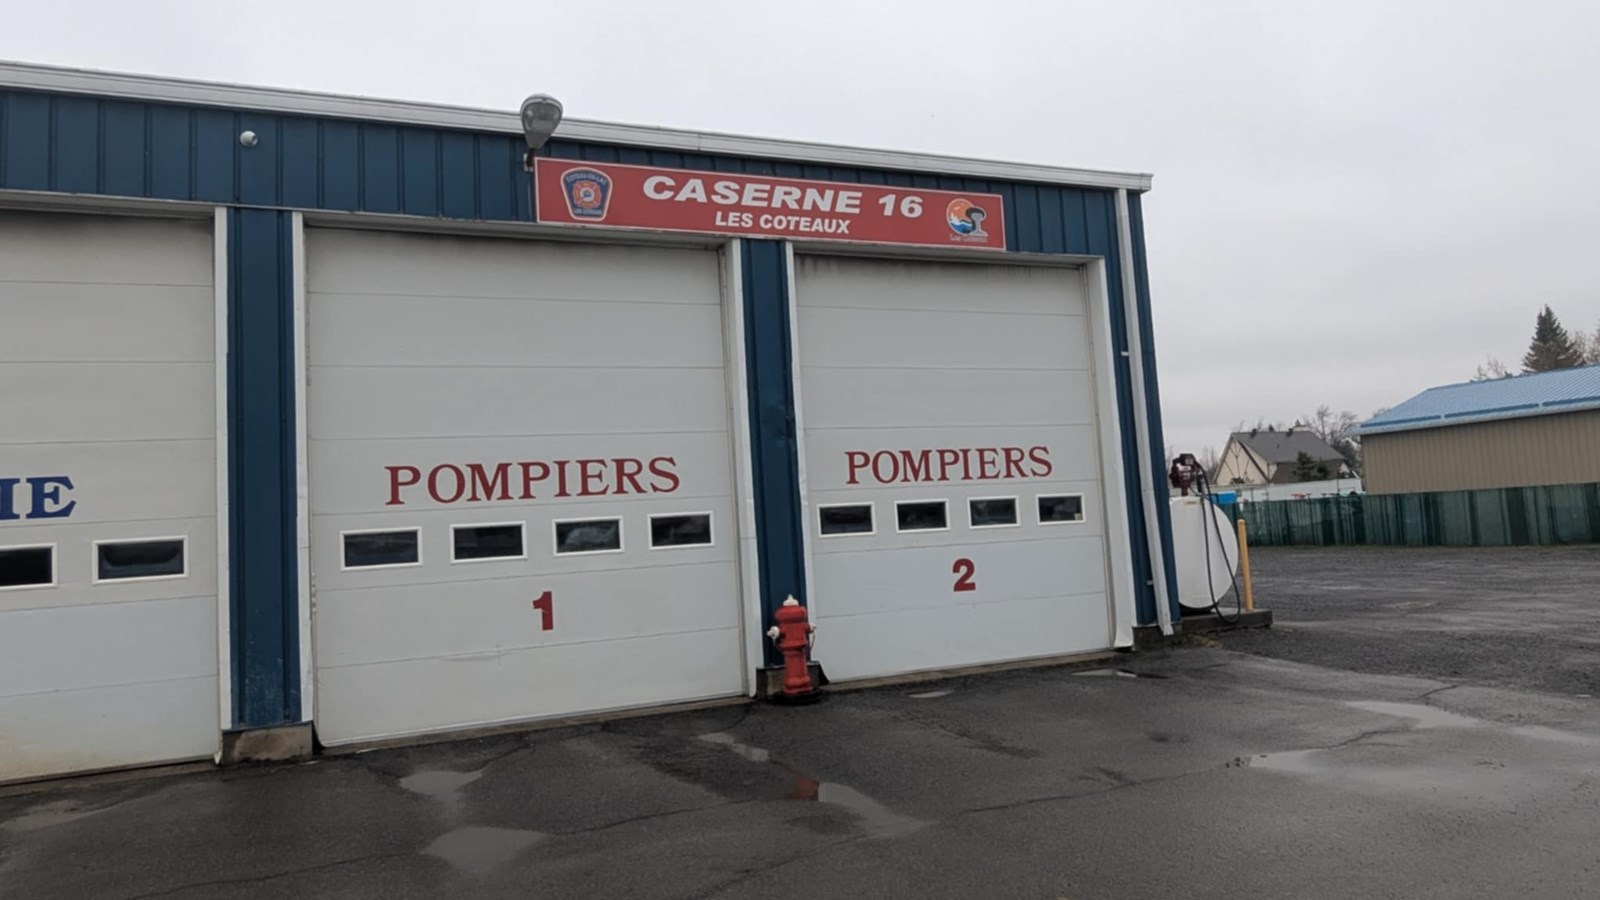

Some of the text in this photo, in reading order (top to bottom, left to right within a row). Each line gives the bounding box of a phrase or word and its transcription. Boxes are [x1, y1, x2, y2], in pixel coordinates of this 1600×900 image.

[643, 175, 923, 218] CASERNE 16
[715, 211, 851, 234] LES COTEAUX
[384, 457, 680, 505] POMPIERS
[845, 446, 1052, 484] POMPIERS
[952, 558, 976, 592] 2
[532, 591, 554, 631] 1
